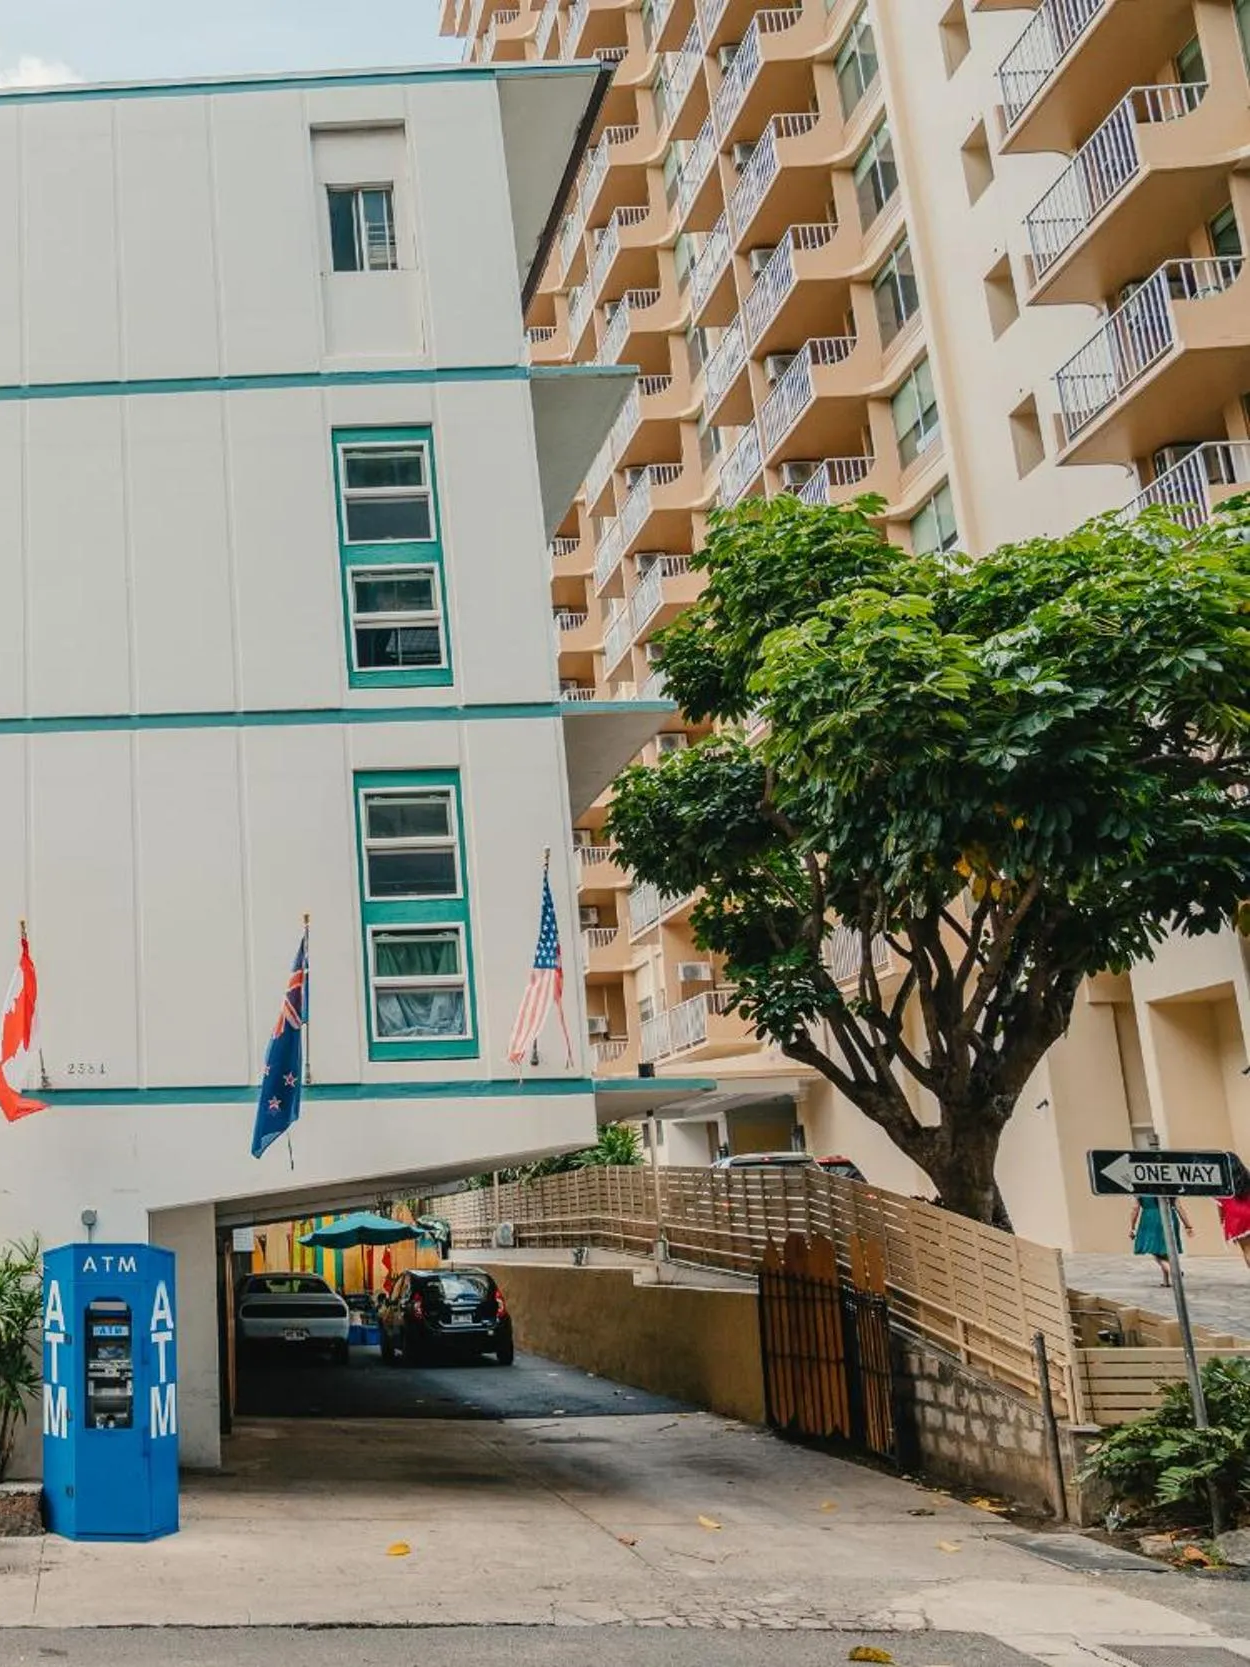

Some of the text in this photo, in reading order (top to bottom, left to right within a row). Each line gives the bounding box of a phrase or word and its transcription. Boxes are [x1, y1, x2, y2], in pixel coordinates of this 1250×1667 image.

[1134, 1164, 1215, 1183] ONE WAY
[82, 1255, 138, 1274] ATM
[43, 1279, 69, 1440] ATM
[150, 1279, 178, 1440] ATM
